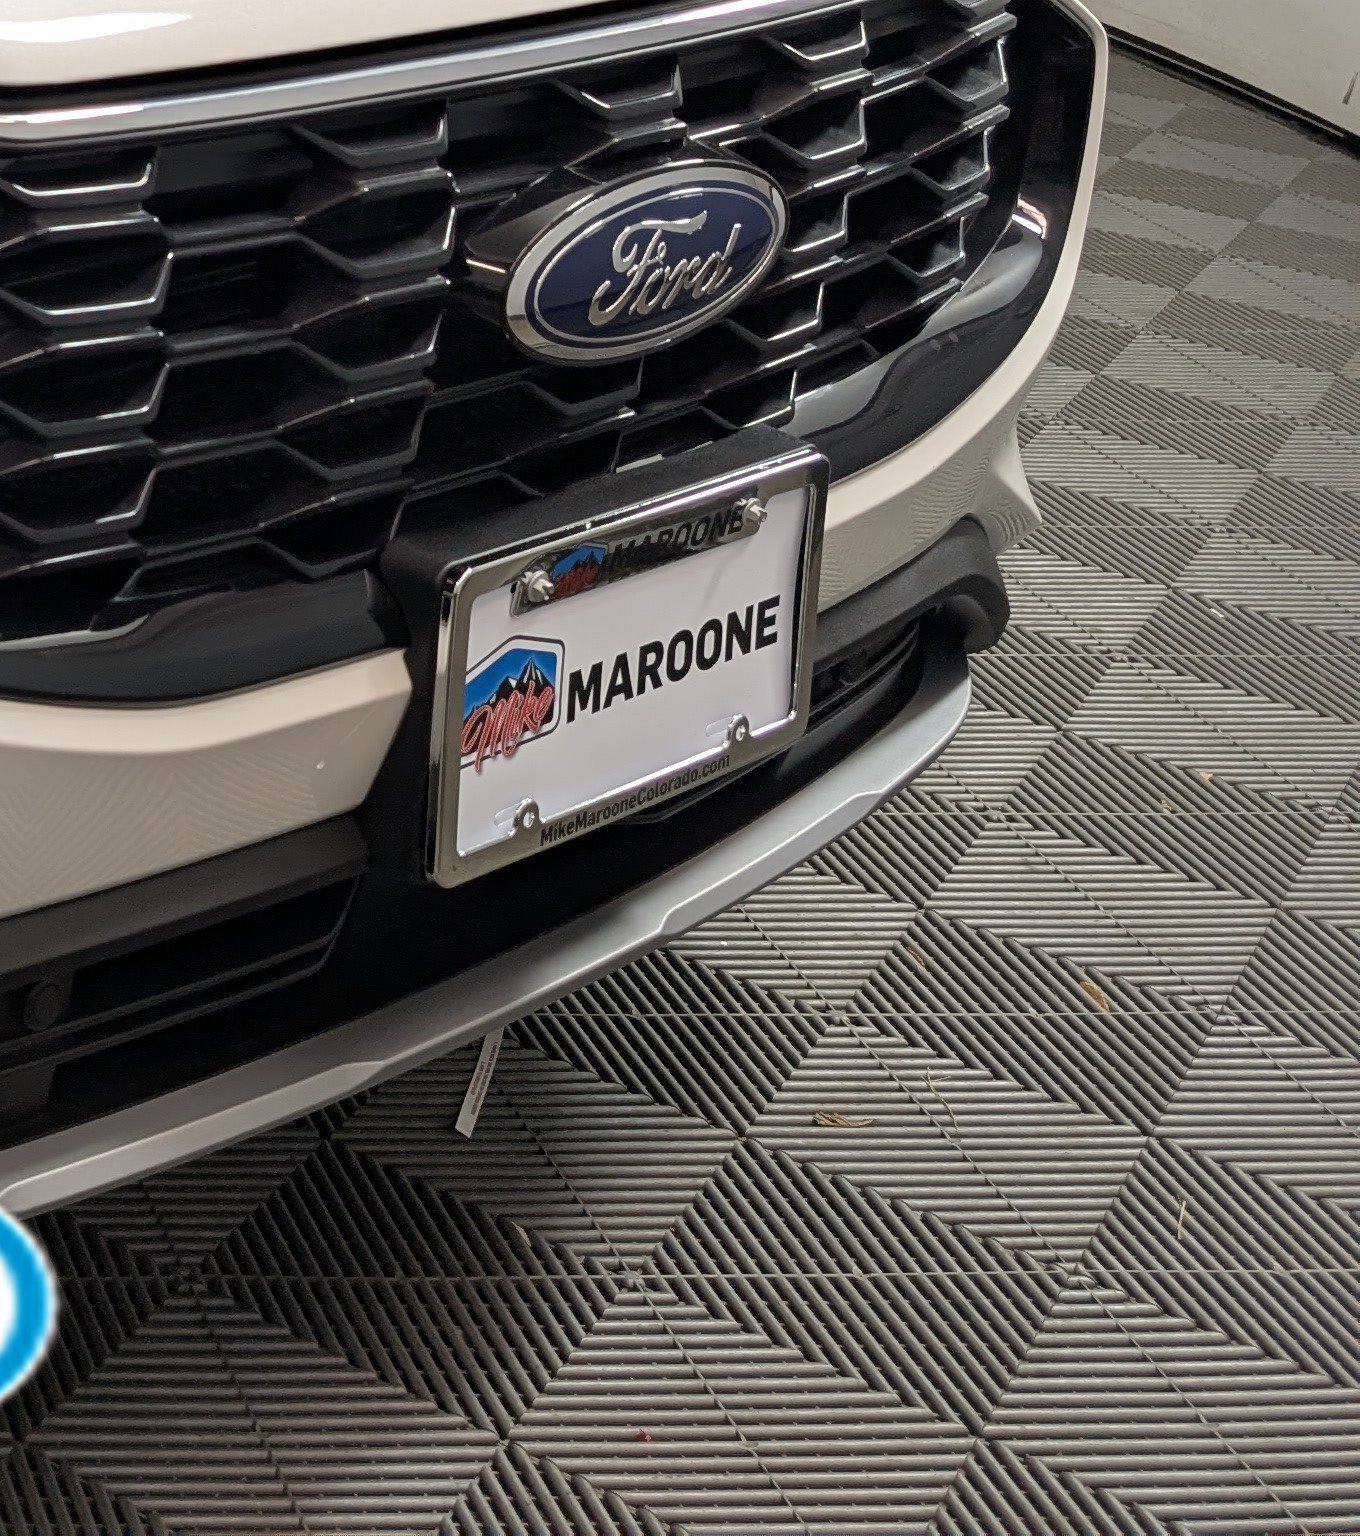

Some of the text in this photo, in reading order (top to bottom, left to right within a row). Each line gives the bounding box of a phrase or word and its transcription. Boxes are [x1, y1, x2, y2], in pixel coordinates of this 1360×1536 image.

[588, 210, 742, 326] Ford
[566, 594, 781, 724] MAROONE
[461, 679, 555, 772] Mike
[539, 754, 731, 846] MikeMarooneColorado.com
